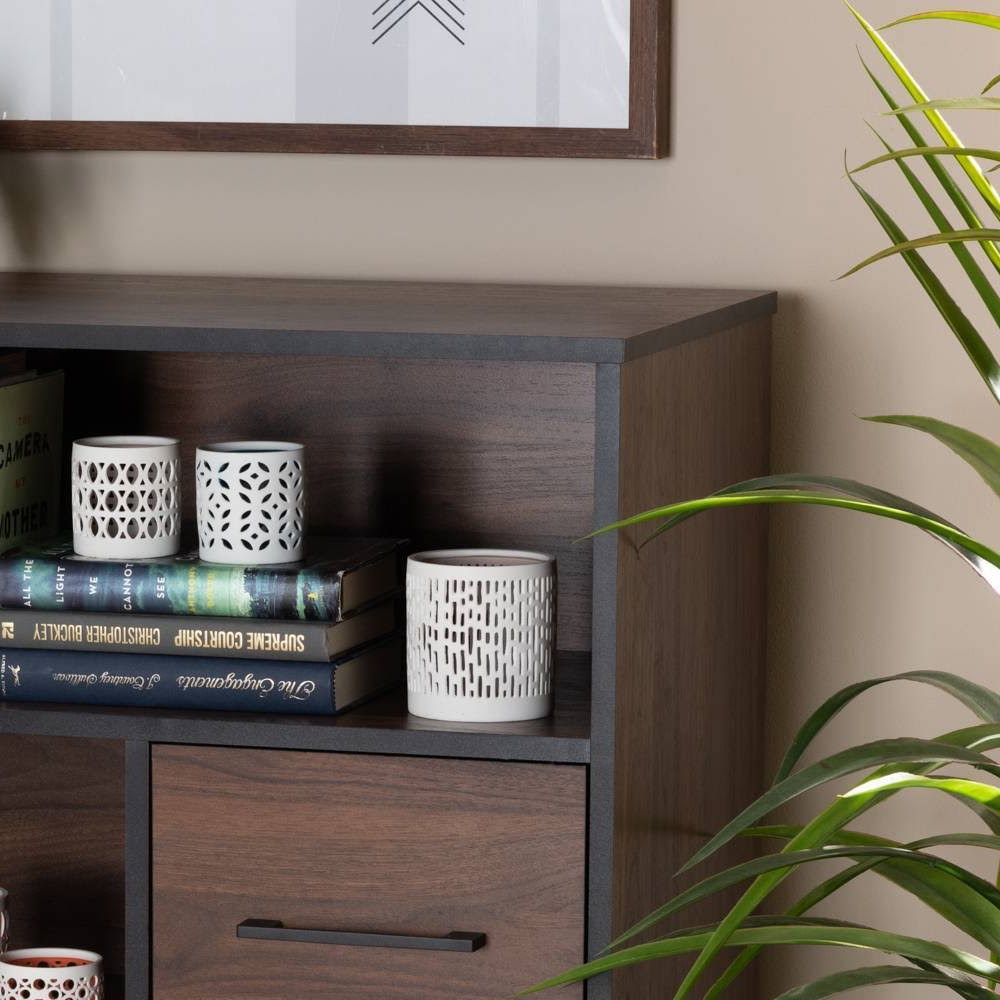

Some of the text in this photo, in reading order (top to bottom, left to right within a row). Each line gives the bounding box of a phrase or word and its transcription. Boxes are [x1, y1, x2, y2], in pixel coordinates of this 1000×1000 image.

[24, 558, 34, 608] ALL THE
[55, 565, 66, 604] LIGHT
[88, 575, 98, 596] WE
[123, 562, 134, 612] CANNOT
[156, 576, 166, 600] SEE
[33, 622, 161, 646] CHRISTOPHER BUCKLEY
[174, 628, 306, 652] SUPREME COURTSHIP
[175, 672, 317, 701] The Engagements
